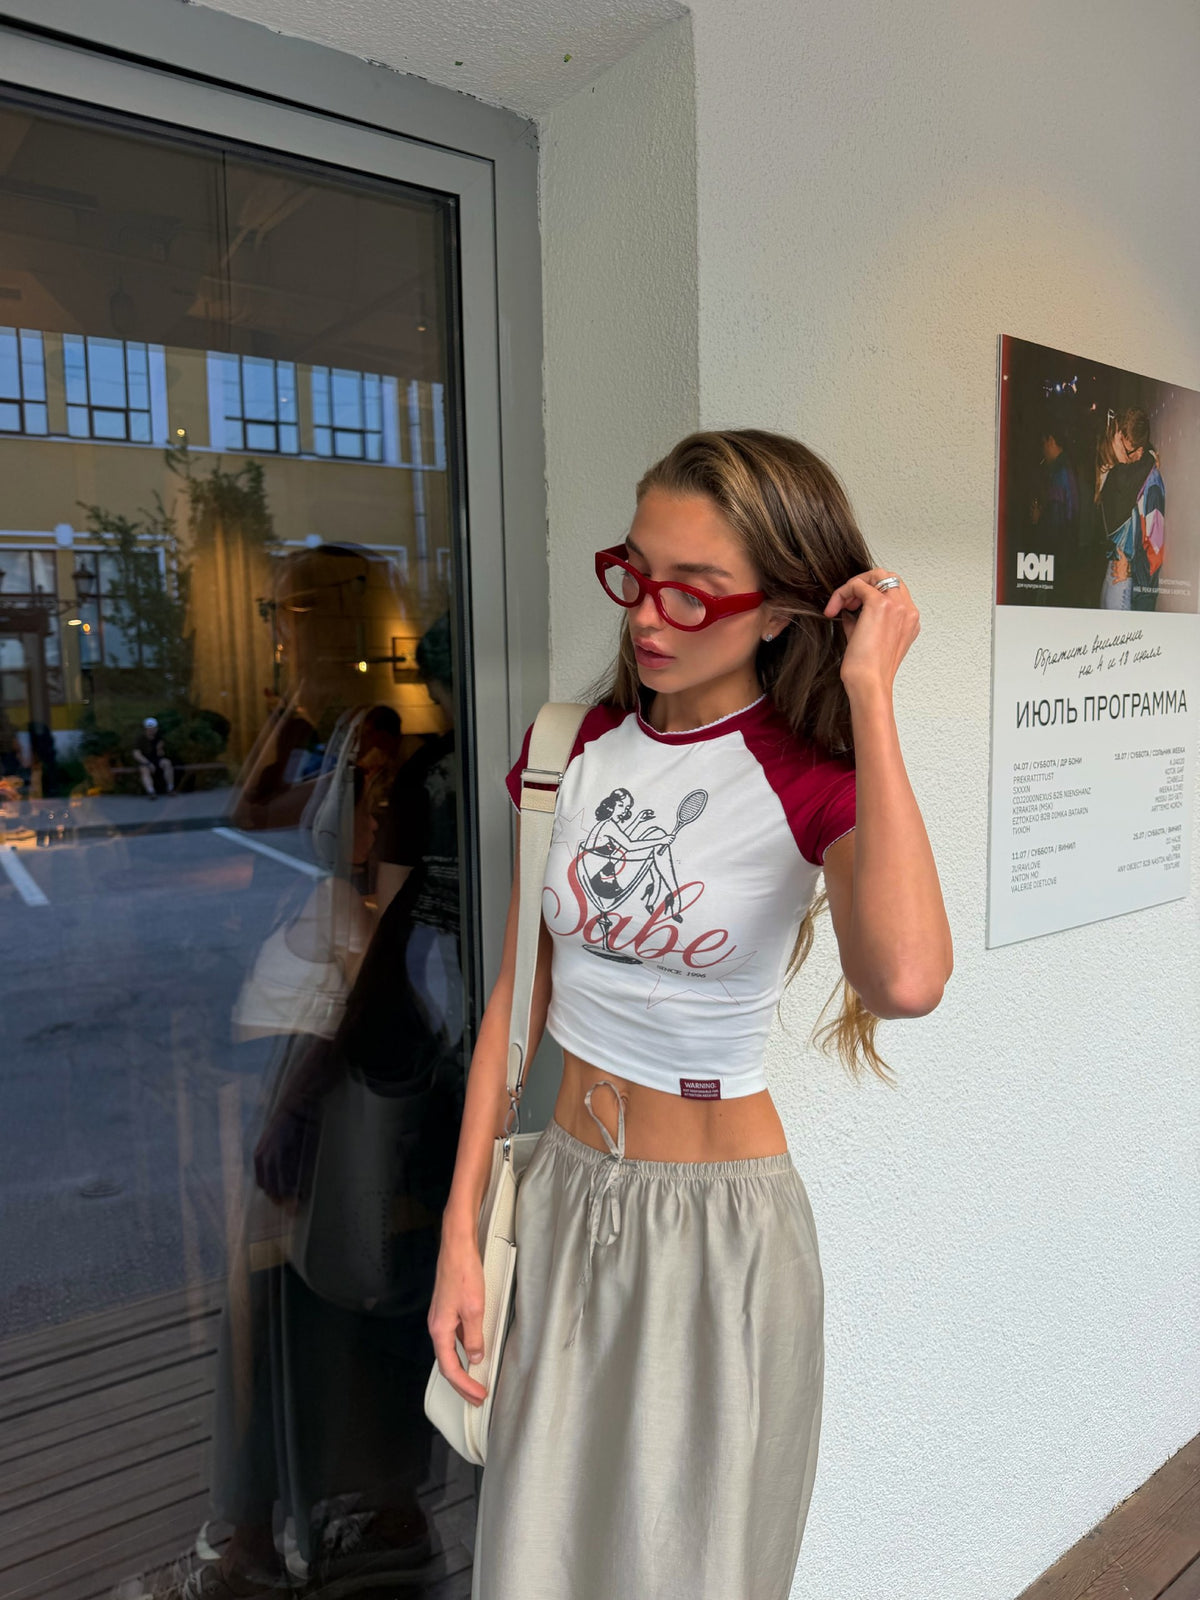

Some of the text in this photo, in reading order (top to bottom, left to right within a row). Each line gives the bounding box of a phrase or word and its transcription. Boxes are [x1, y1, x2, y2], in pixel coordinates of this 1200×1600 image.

[1078, 664, 1093, 678] на
[1016, 688, 1188, 729] ИЮЛЬ ПРОГРАММА
[1013, 762, 1029, 771] 04.07
[1032, 759, 1056, 769] СУББОТА
[1031, 846, 1054, 857] СУББОТА
[1011, 874, 1029, 883] ANTON
[542, 846, 737, 968] Sabe
[656, 964, 682, 976] SINCE
